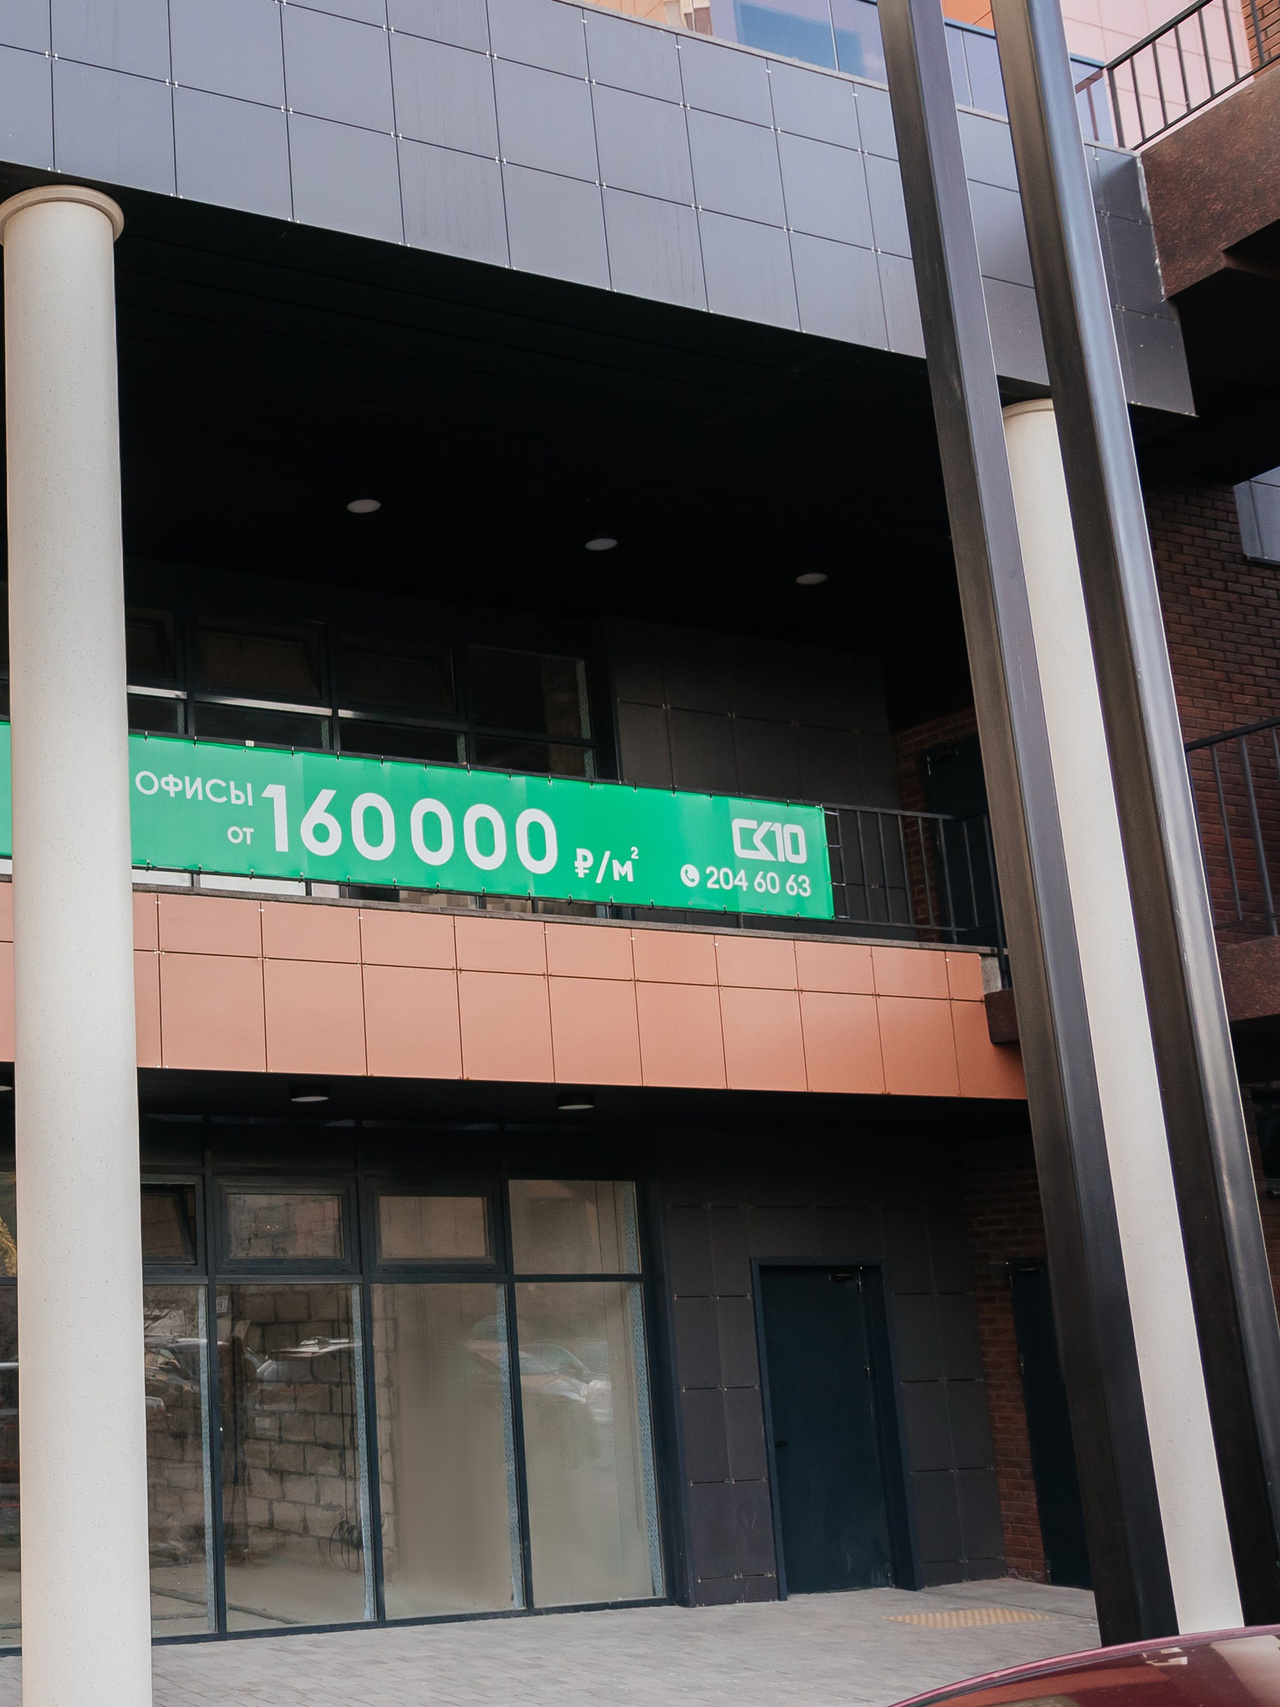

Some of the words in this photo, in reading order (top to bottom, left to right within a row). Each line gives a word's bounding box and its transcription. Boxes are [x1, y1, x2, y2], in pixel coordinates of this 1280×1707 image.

[135, 770, 253, 806] ОФИСЫ
[705, 866, 749, 891] 204
[753, 871, 780, 894] 60
[785, 874, 812, 897] 63
